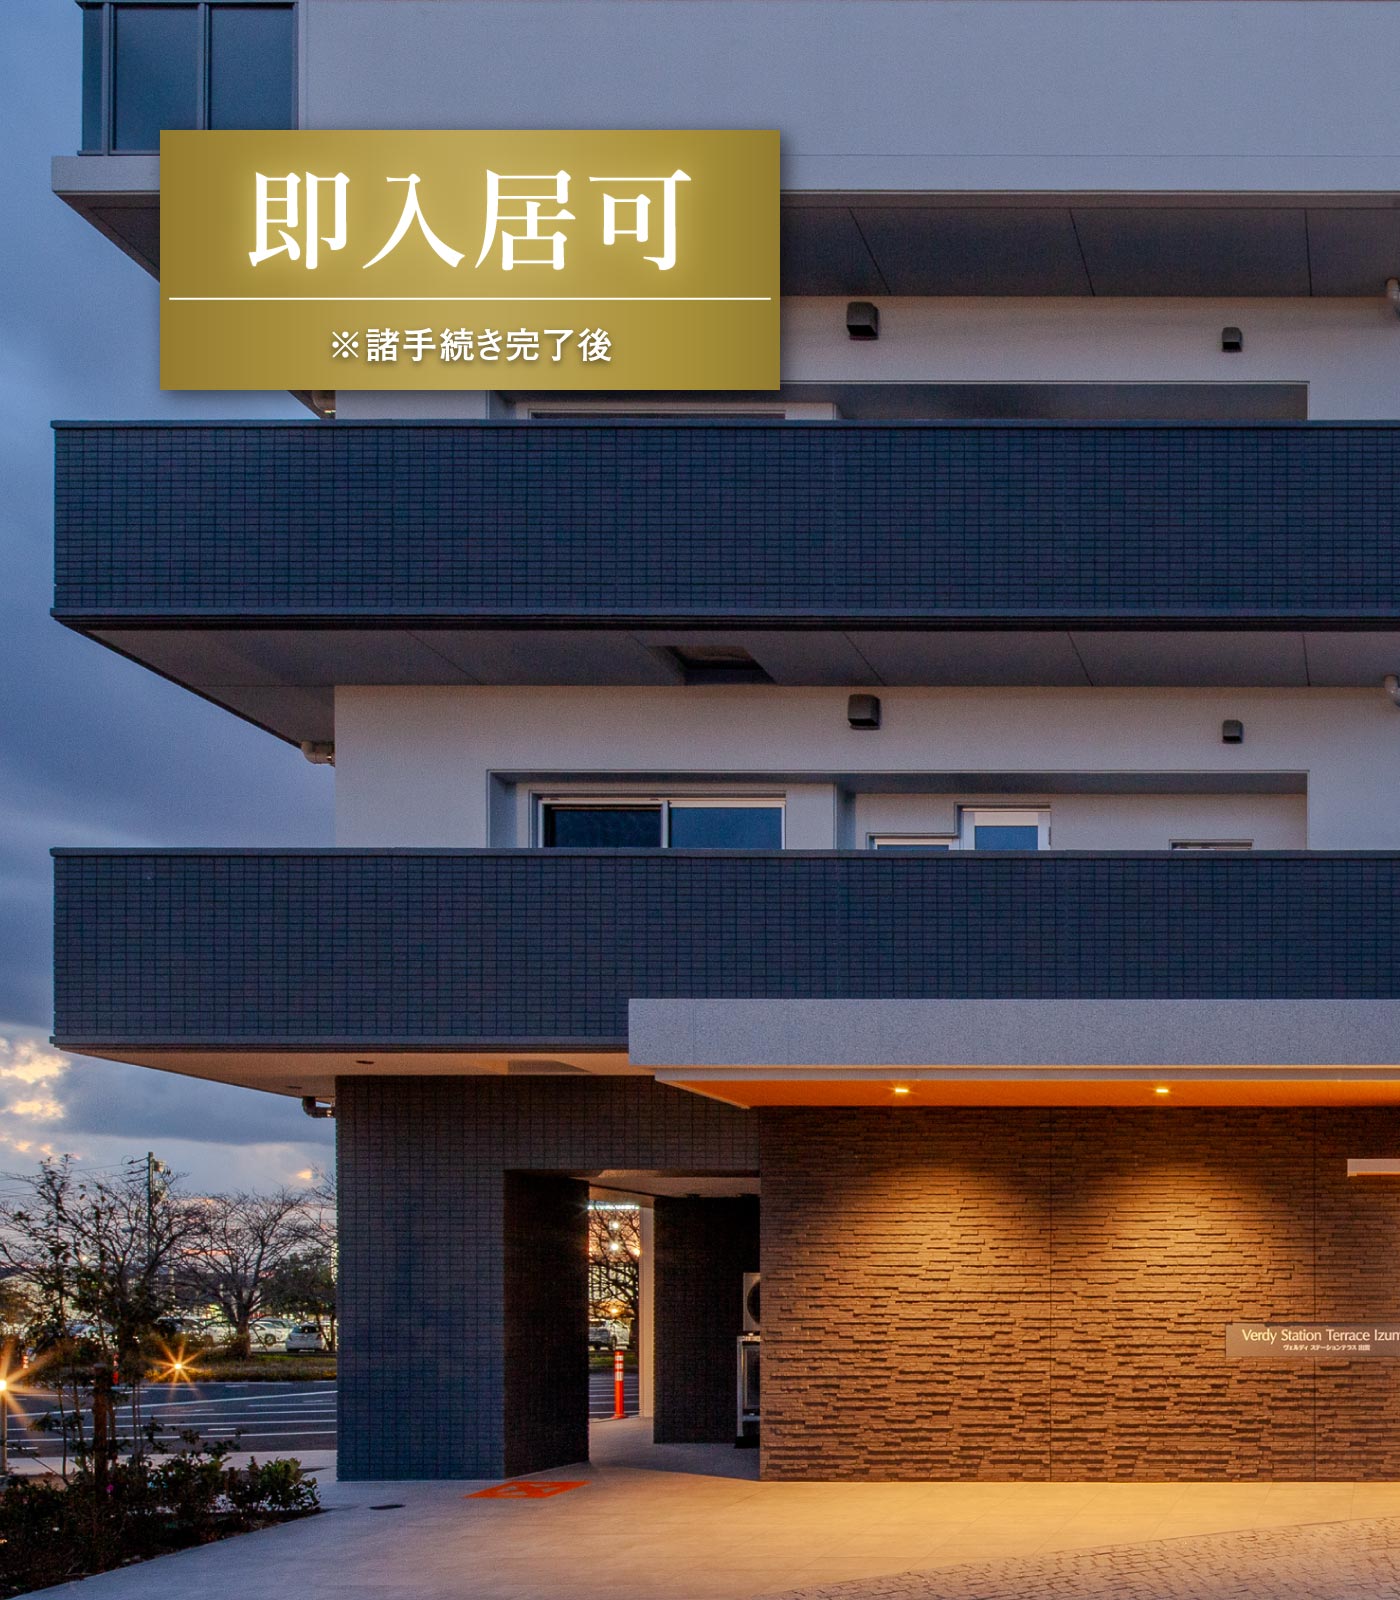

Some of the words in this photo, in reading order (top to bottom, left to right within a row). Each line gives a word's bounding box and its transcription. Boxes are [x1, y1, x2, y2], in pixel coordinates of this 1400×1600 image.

[1242, 1328, 1277, 1344] Verdy
[1281, 1328, 1322, 1341] Station
[1326, 1328, 1370, 1341] Terrace
